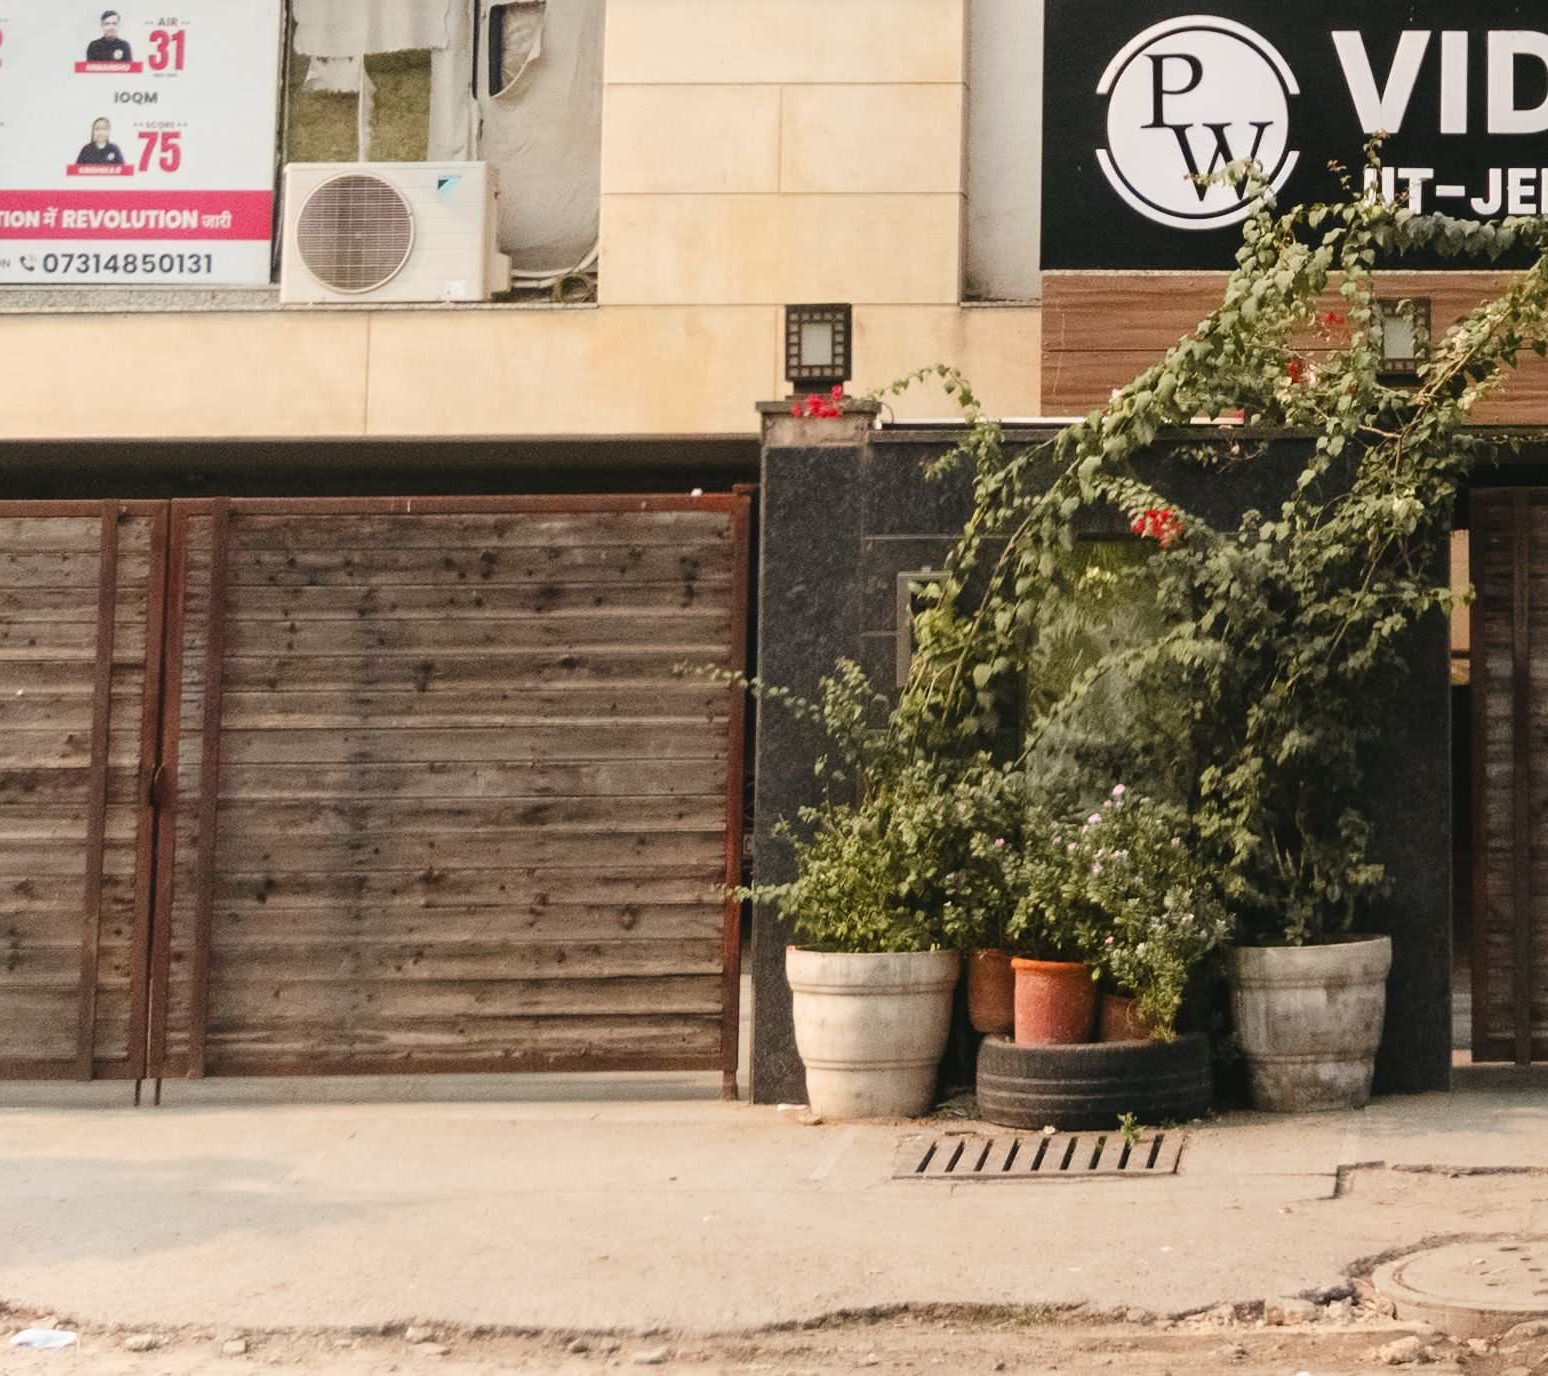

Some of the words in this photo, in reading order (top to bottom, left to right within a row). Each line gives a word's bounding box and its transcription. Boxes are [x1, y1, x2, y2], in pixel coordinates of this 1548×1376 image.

[158, 18, 178, 26] AIR
[148, 30, 186, 70] 31
[114, 92, 159, 105] IOQM
[145, 121, 175, 129] SCORE
[137, 131, 181, 173] 75
[62, 210, 198, 229] REVOLUTION
[201, 211, 232, 229] जारी
[43, 253, 213, 274] 07314850131
